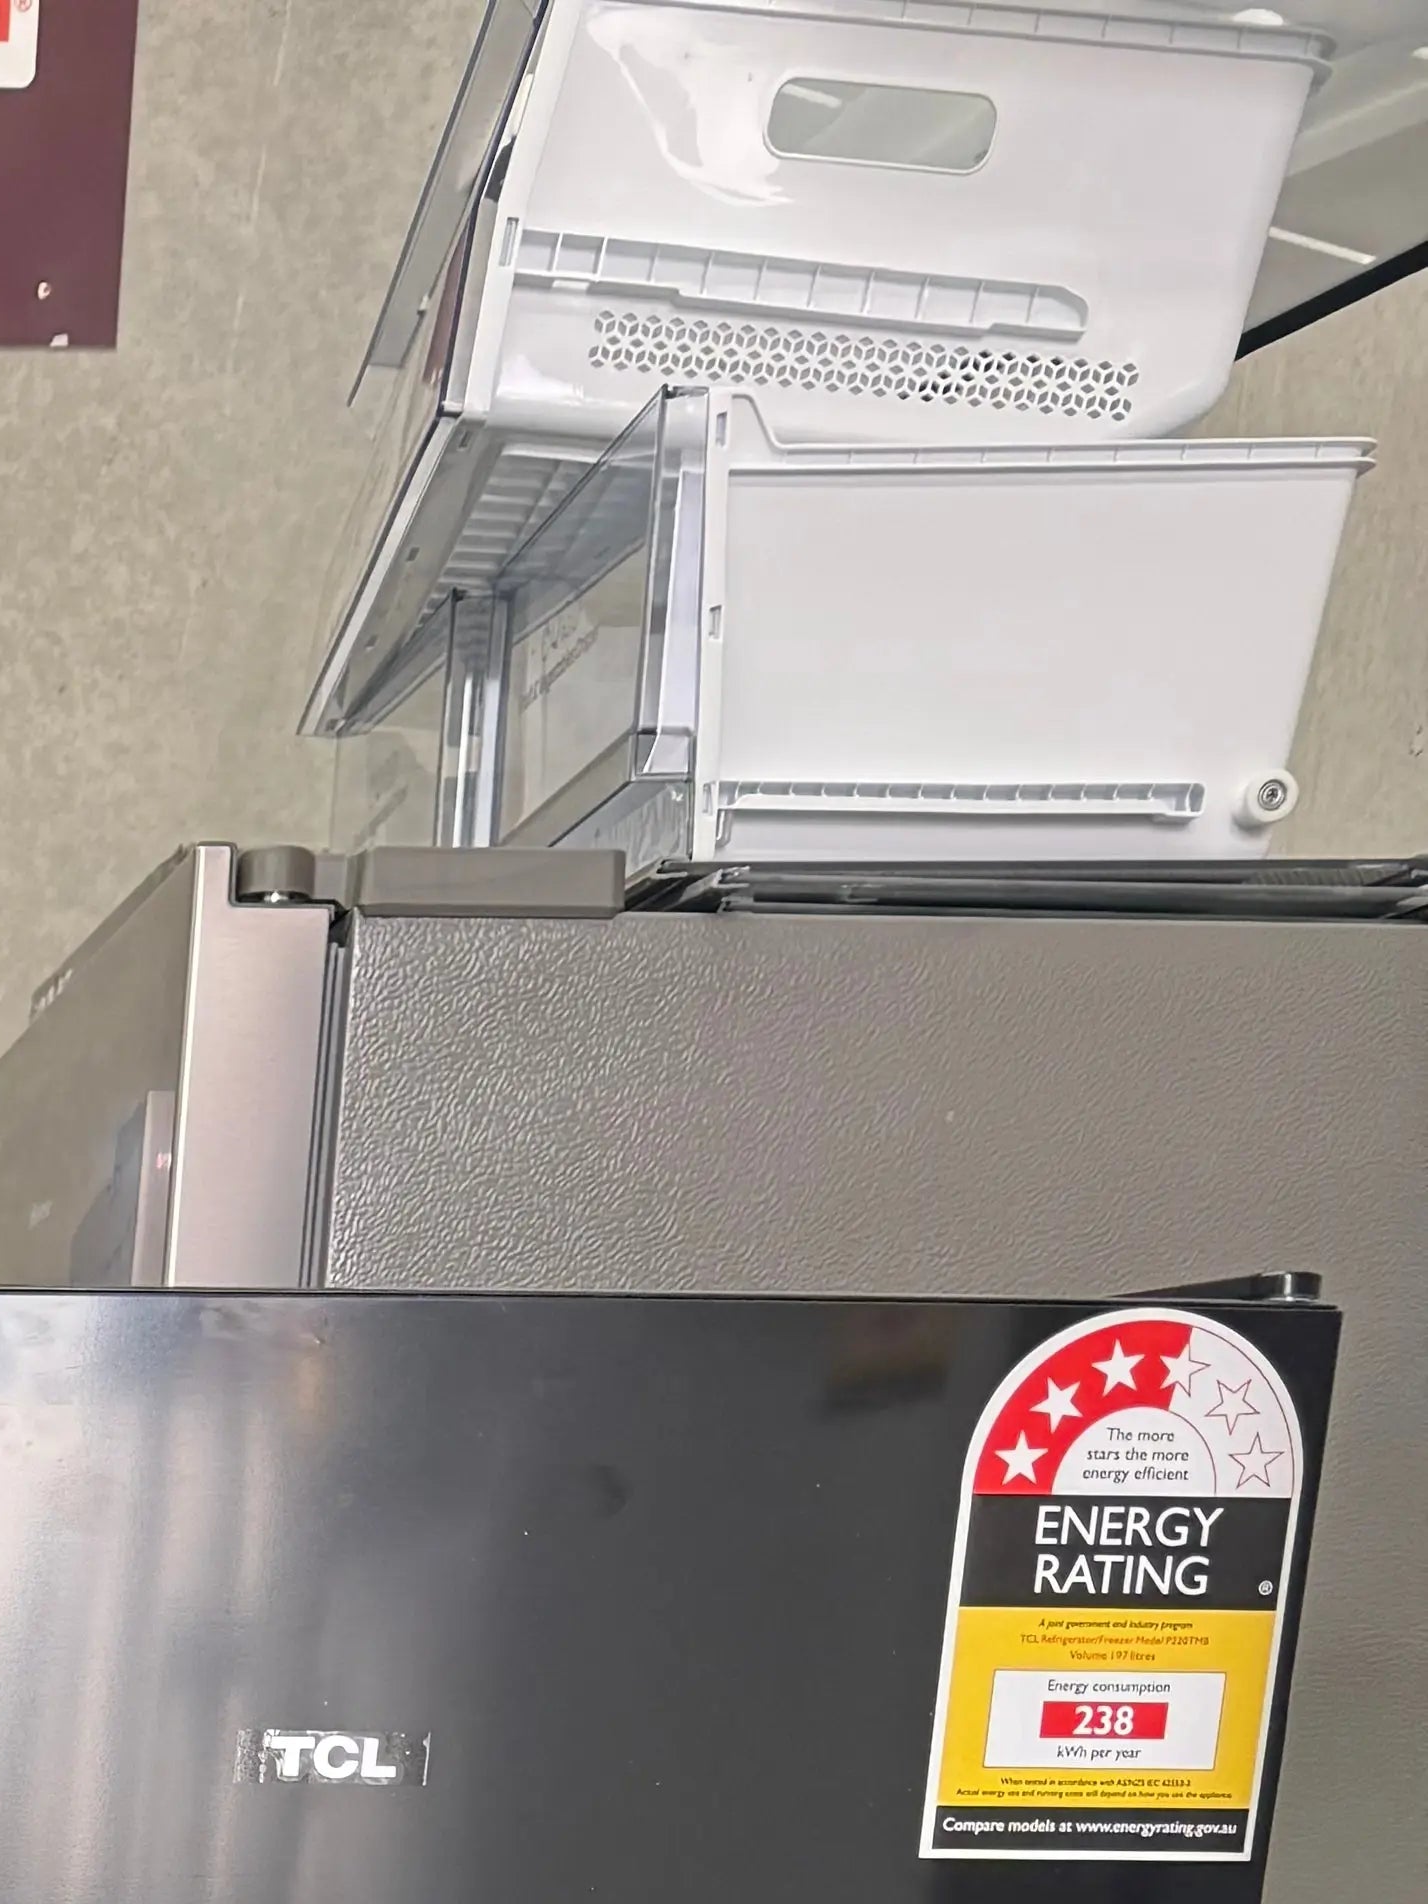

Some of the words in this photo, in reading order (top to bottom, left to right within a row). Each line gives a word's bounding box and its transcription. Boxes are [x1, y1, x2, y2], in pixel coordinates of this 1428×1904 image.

[1106, 1427, 1133, 1442] The
[1137, 1430, 1175, 1442] more
[1087, 1449, 1120, 1462] stars
[1125, 1449, 1148, 1461] the
[1151, 1450, 1189, 1462] more
[1082, 1469, 1131, 1484] energy
[1134, 1467, 1189, 1481] efficient
[1035, 1505, 1224, 1547] ENERGY
[1034, 1554, 1210, 1595] RATING
[1048, 1679, 1089, 1695] Energy
[1092, 1682, 1171, 1696] consumption
[1072, 1704, 1134, 1736] 238
[270, 1734, 397, 1779] TCL
[1056, 1746, 1087, 1758] kWh
[1090, 1748, 1111, 1761] per
[1114, 1748, 1142, 1760] year
[942, 1817, 1005, 1836] Compare
[1008, 1819, 1056, 1833] models
[1059, 1820, 1072, 1833] at
[1075, 1820, 1237, 1838] www.energyrating.gov.au
